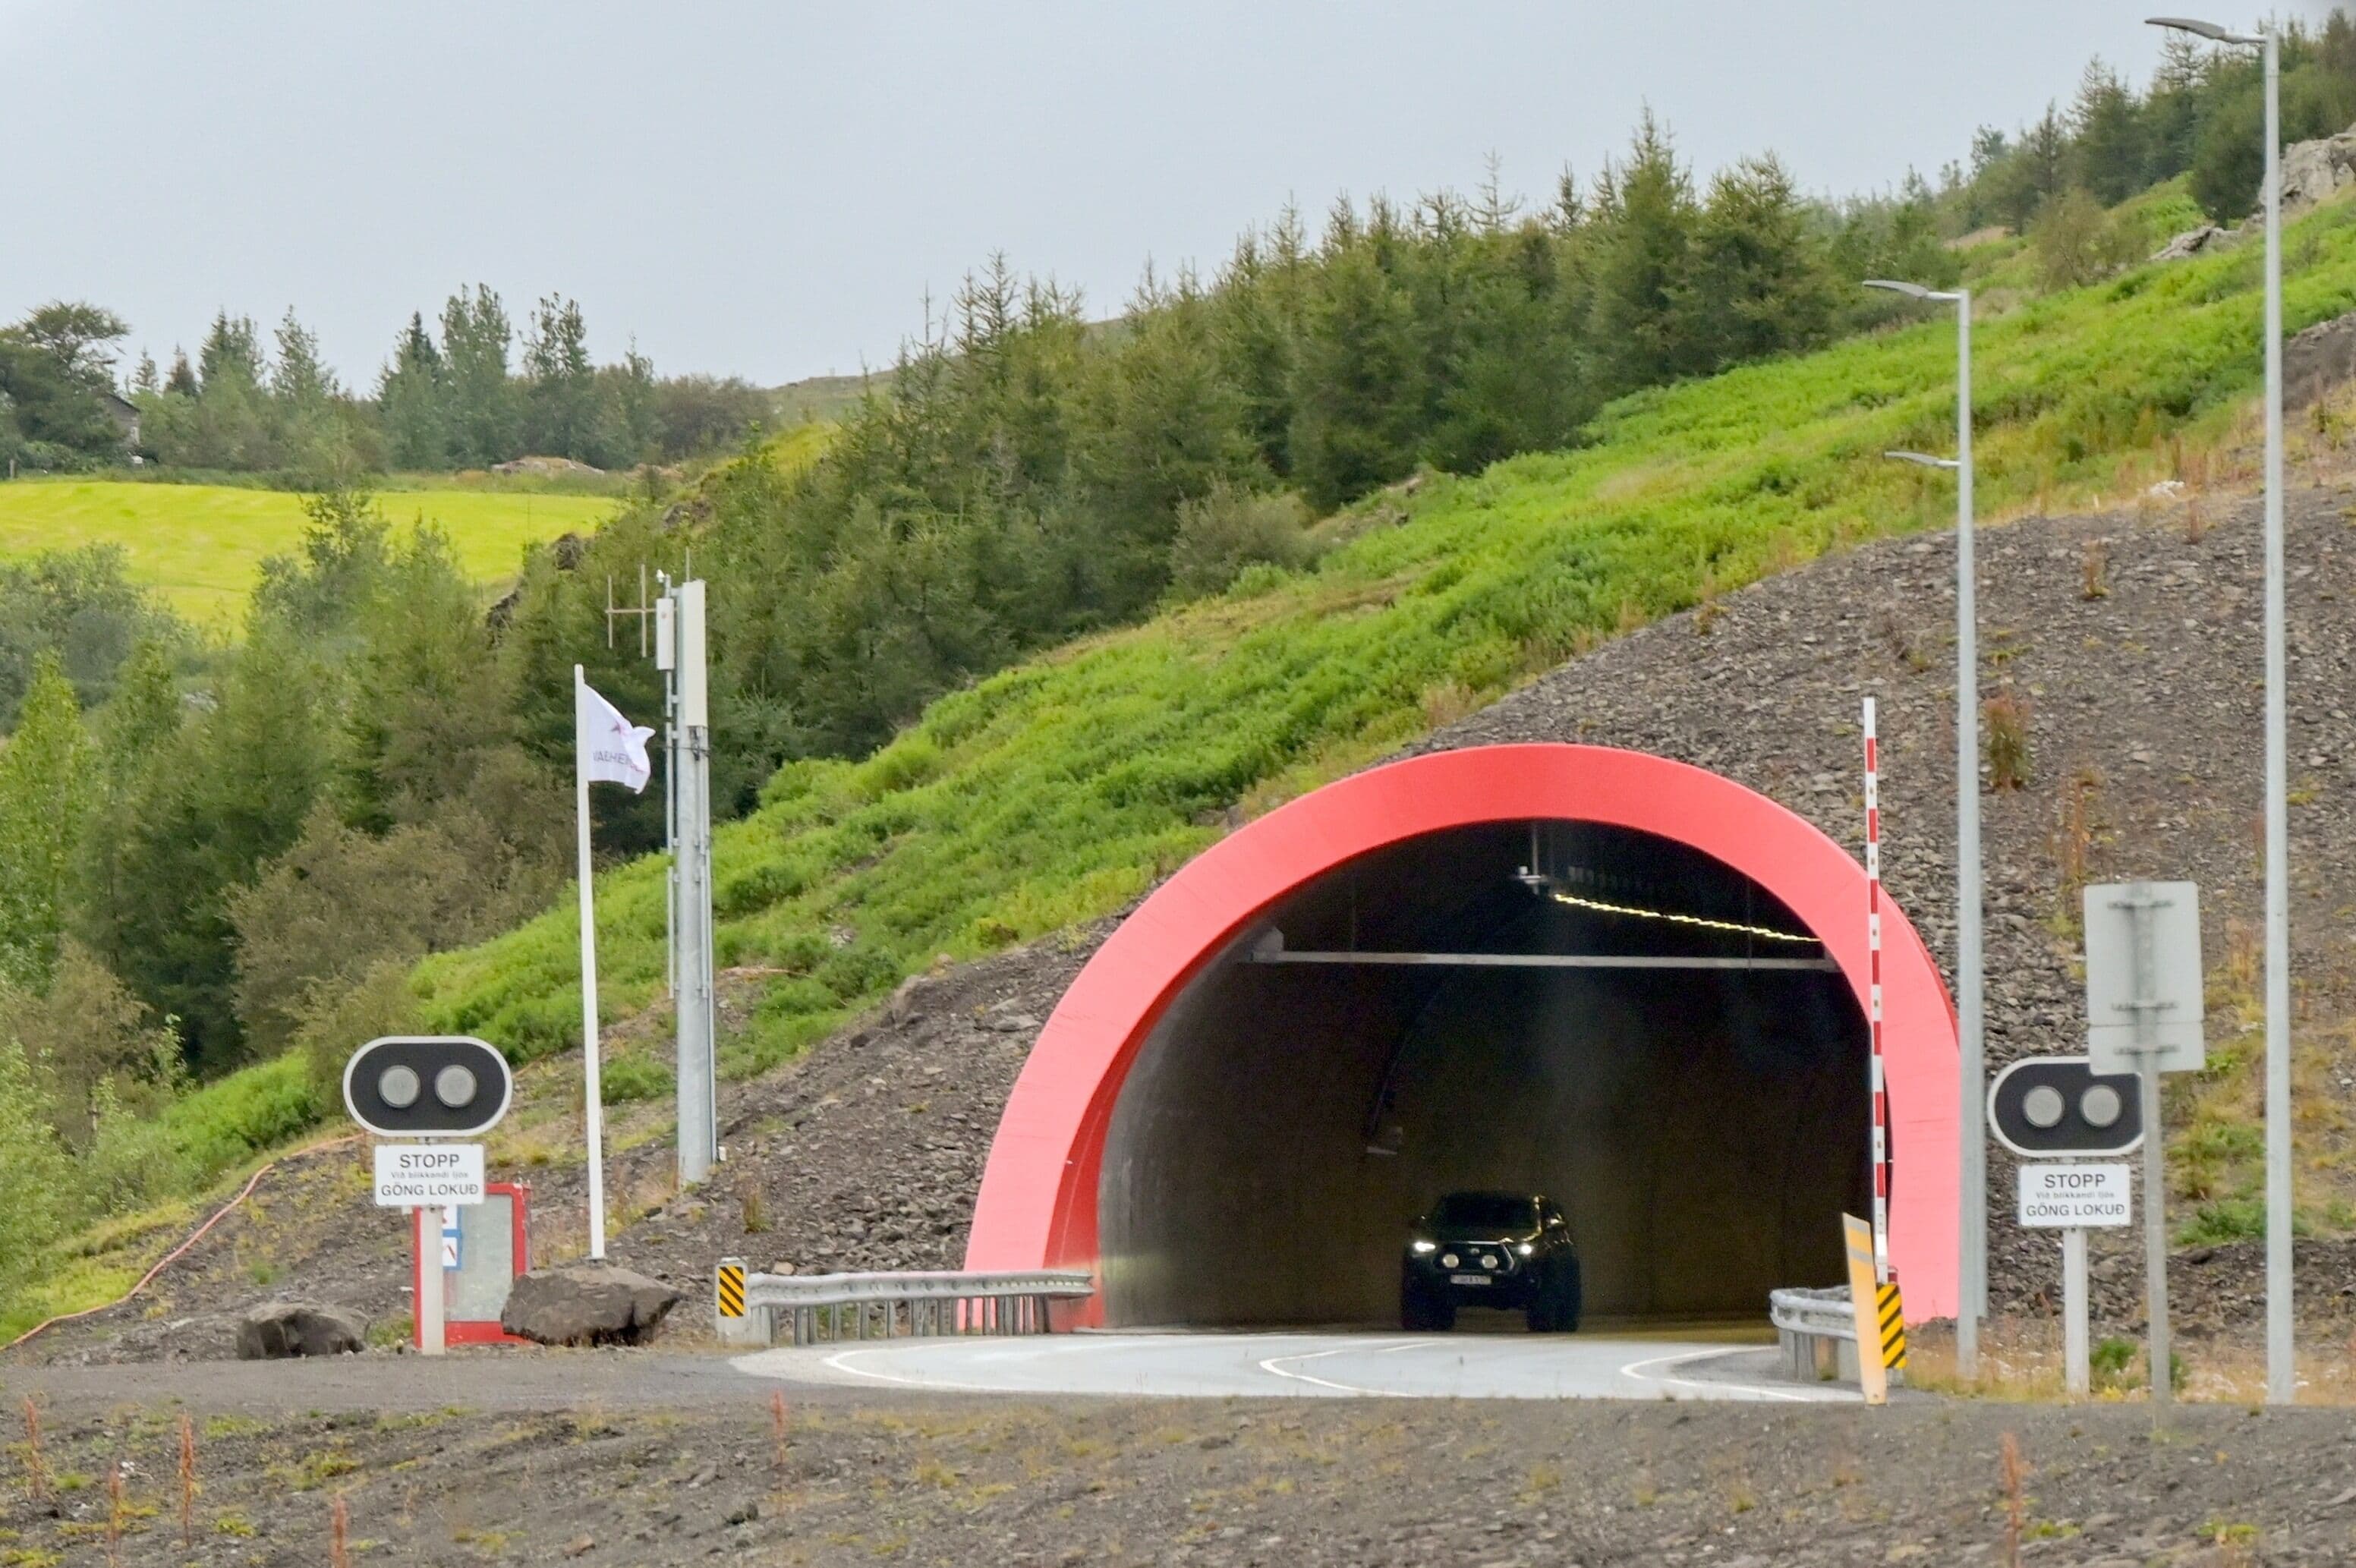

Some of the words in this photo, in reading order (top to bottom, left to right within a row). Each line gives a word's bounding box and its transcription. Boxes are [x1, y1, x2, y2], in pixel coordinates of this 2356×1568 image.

[399, 1154, 460, 1168] STOPP
[381, 1181, 424, 1196] GÖNG
[429, 1183, 479, 1195] LOKUÐ
[2044, 1173, 2106, 1189] STOPP
[2027, 1201, 2070, 1217] GÖNG
[2074, 1204, 2125, 1216] LOKUÐ
